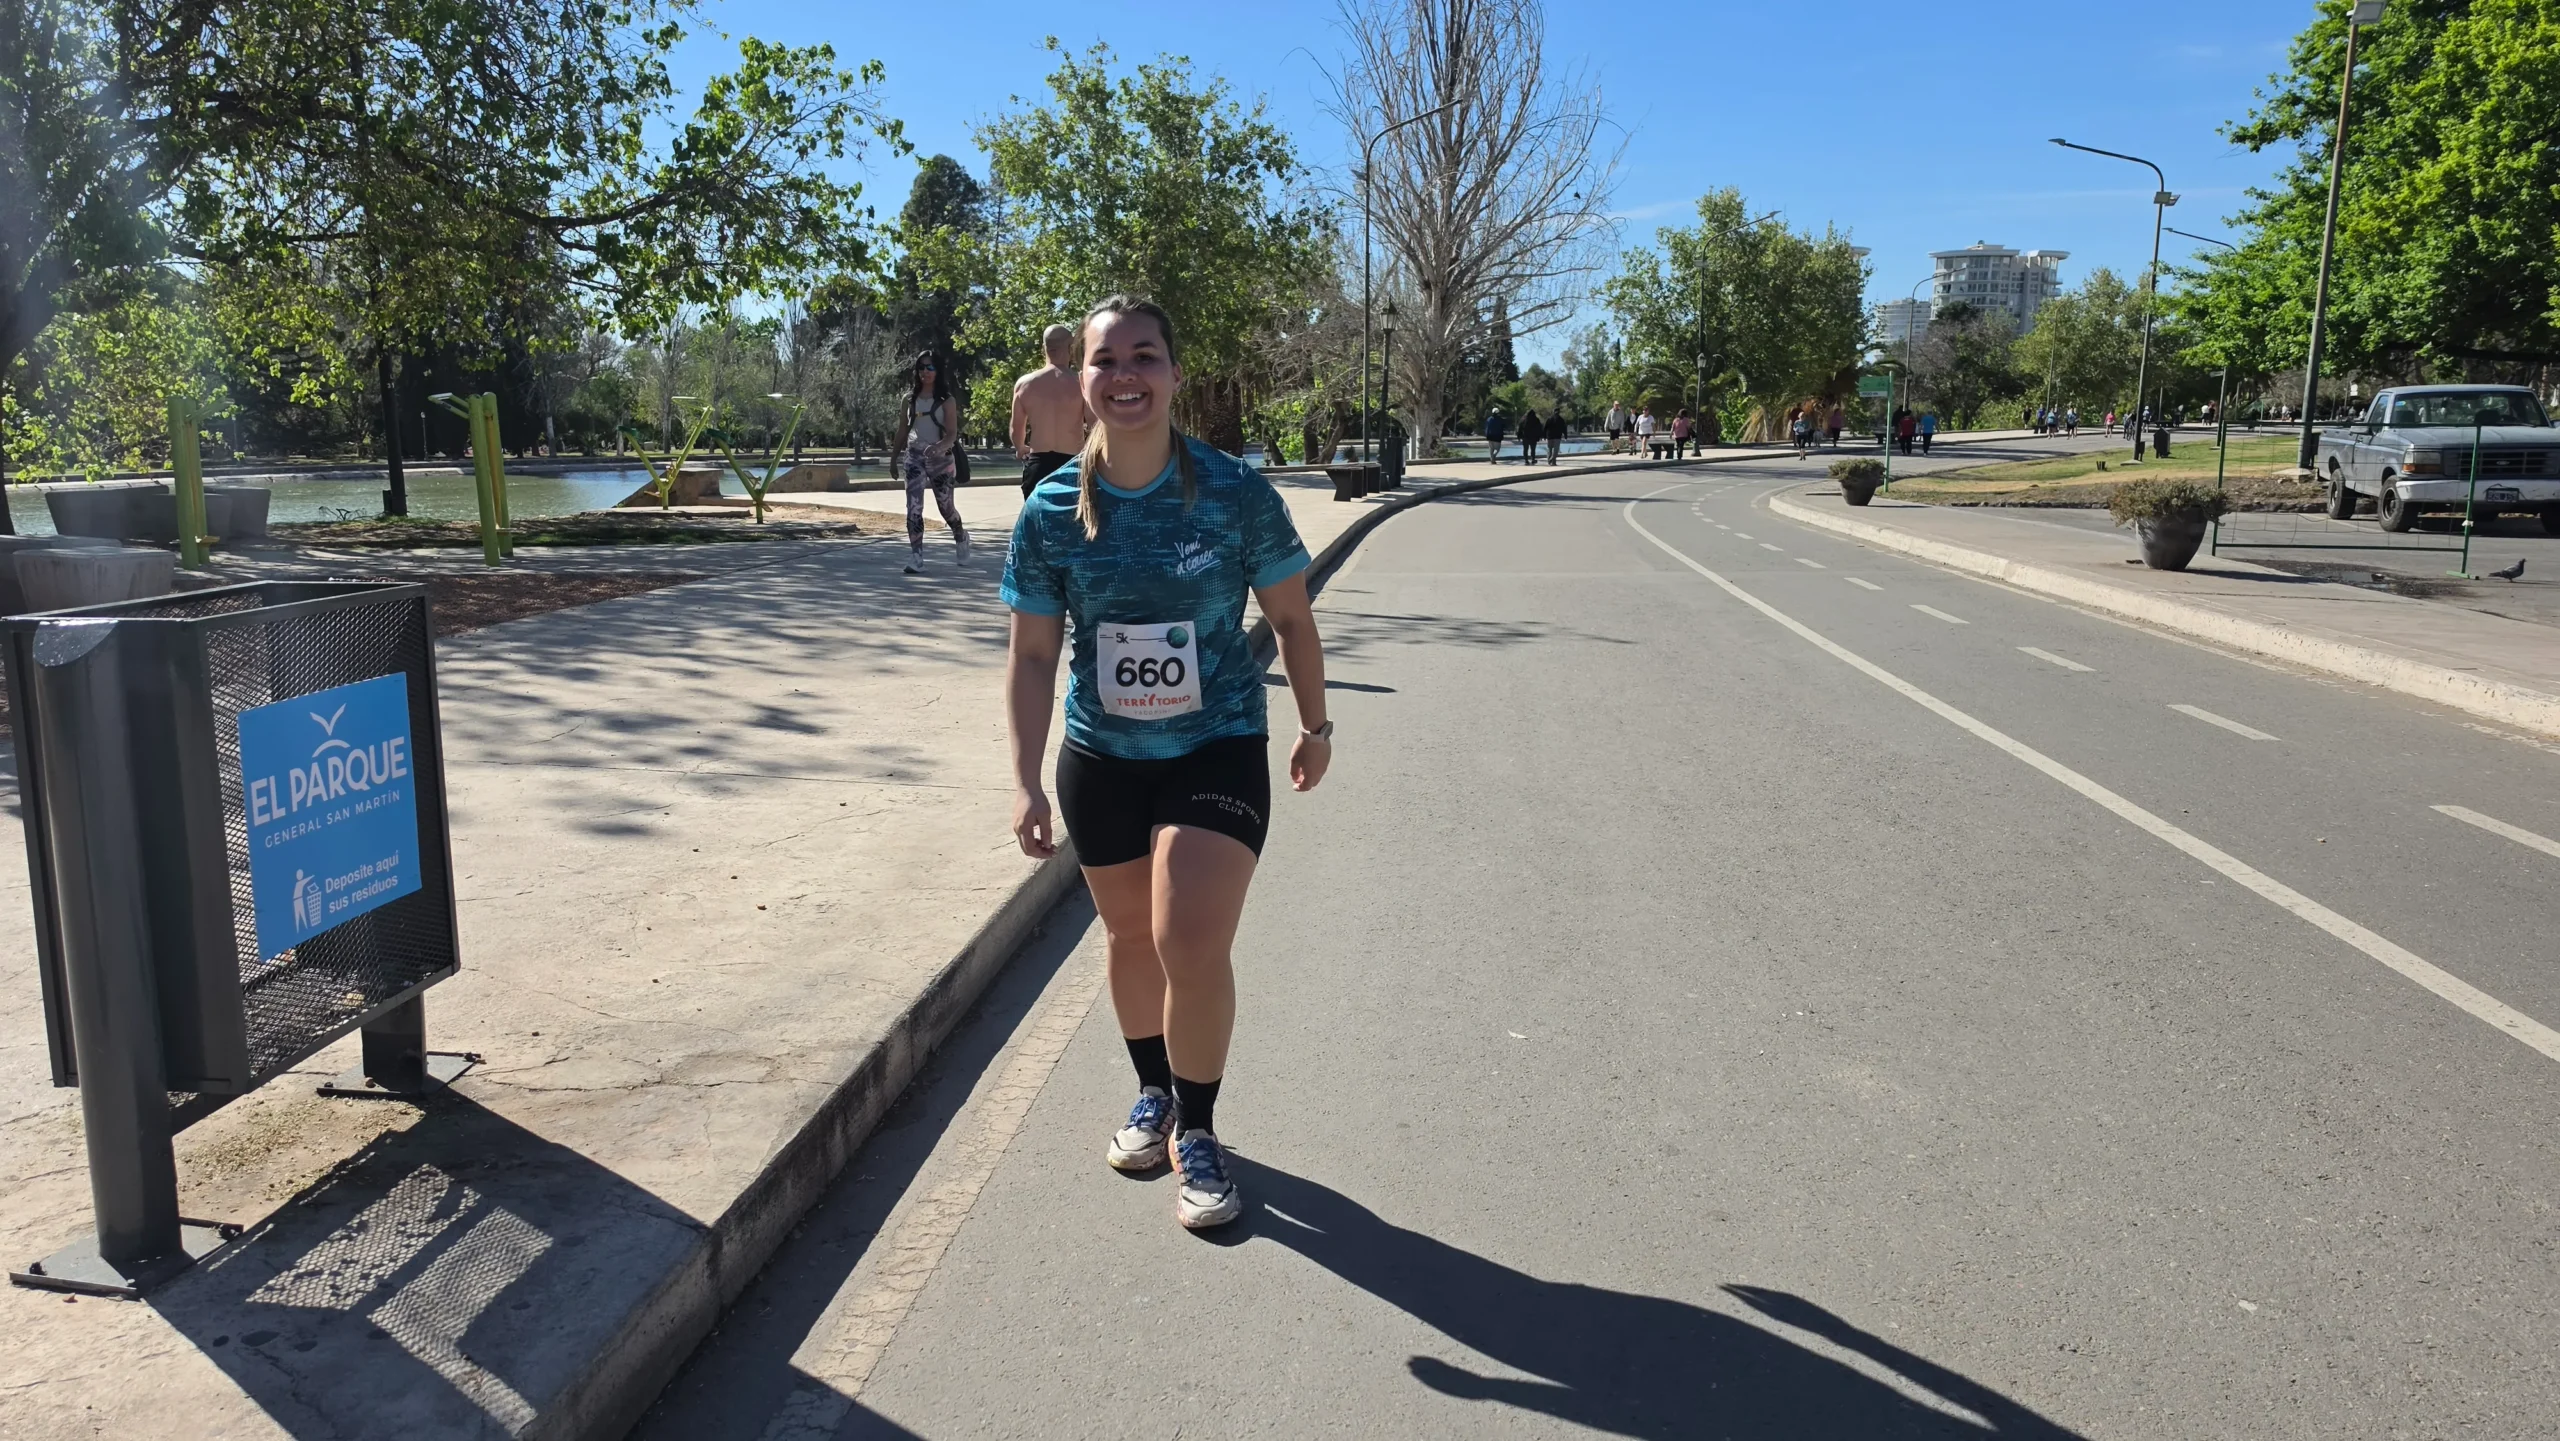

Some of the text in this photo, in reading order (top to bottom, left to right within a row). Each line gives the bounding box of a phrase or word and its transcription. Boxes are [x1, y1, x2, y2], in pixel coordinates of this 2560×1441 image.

[1177, 562, 1185, 575] a
[1116, 657, 1185, 687] 660
[1116, 693, 1191, 707] TERRITORIO
[251, 737, 407, 826] EL PARQUE
[265, 790, 400, 848] GENERAL SAN MARTÍN
[1192, 793, 1261, 825] ADIDAS SPORTS
[1218, 802, 1243, 816] CLUB
[325, 850, 399, 893] Deposite aquí
[329, 875, 398, 913] sus residuos
